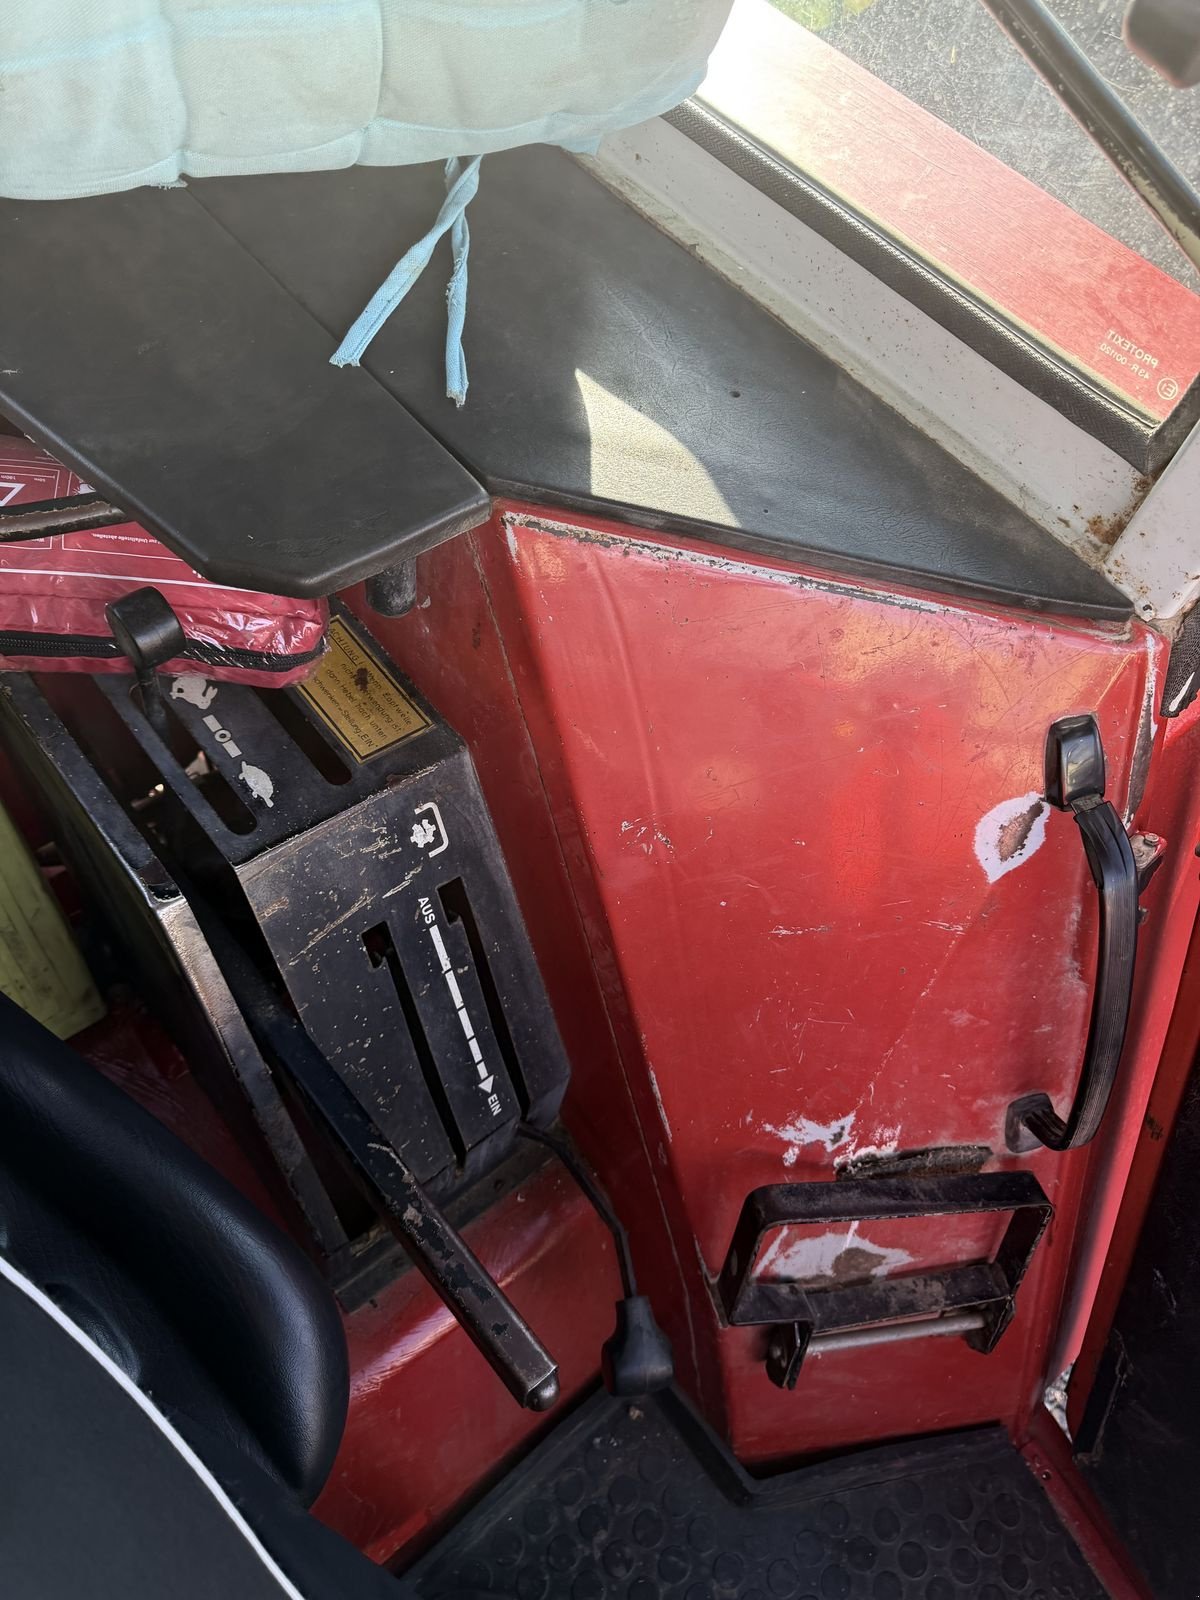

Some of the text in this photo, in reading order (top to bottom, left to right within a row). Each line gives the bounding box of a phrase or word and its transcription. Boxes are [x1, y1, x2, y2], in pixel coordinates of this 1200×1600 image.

[326, 669, 387, 739] dann Hebel nach unten
[418, 896, 435, 924] AUS
[488, 1093, 502, 1116] EIN
